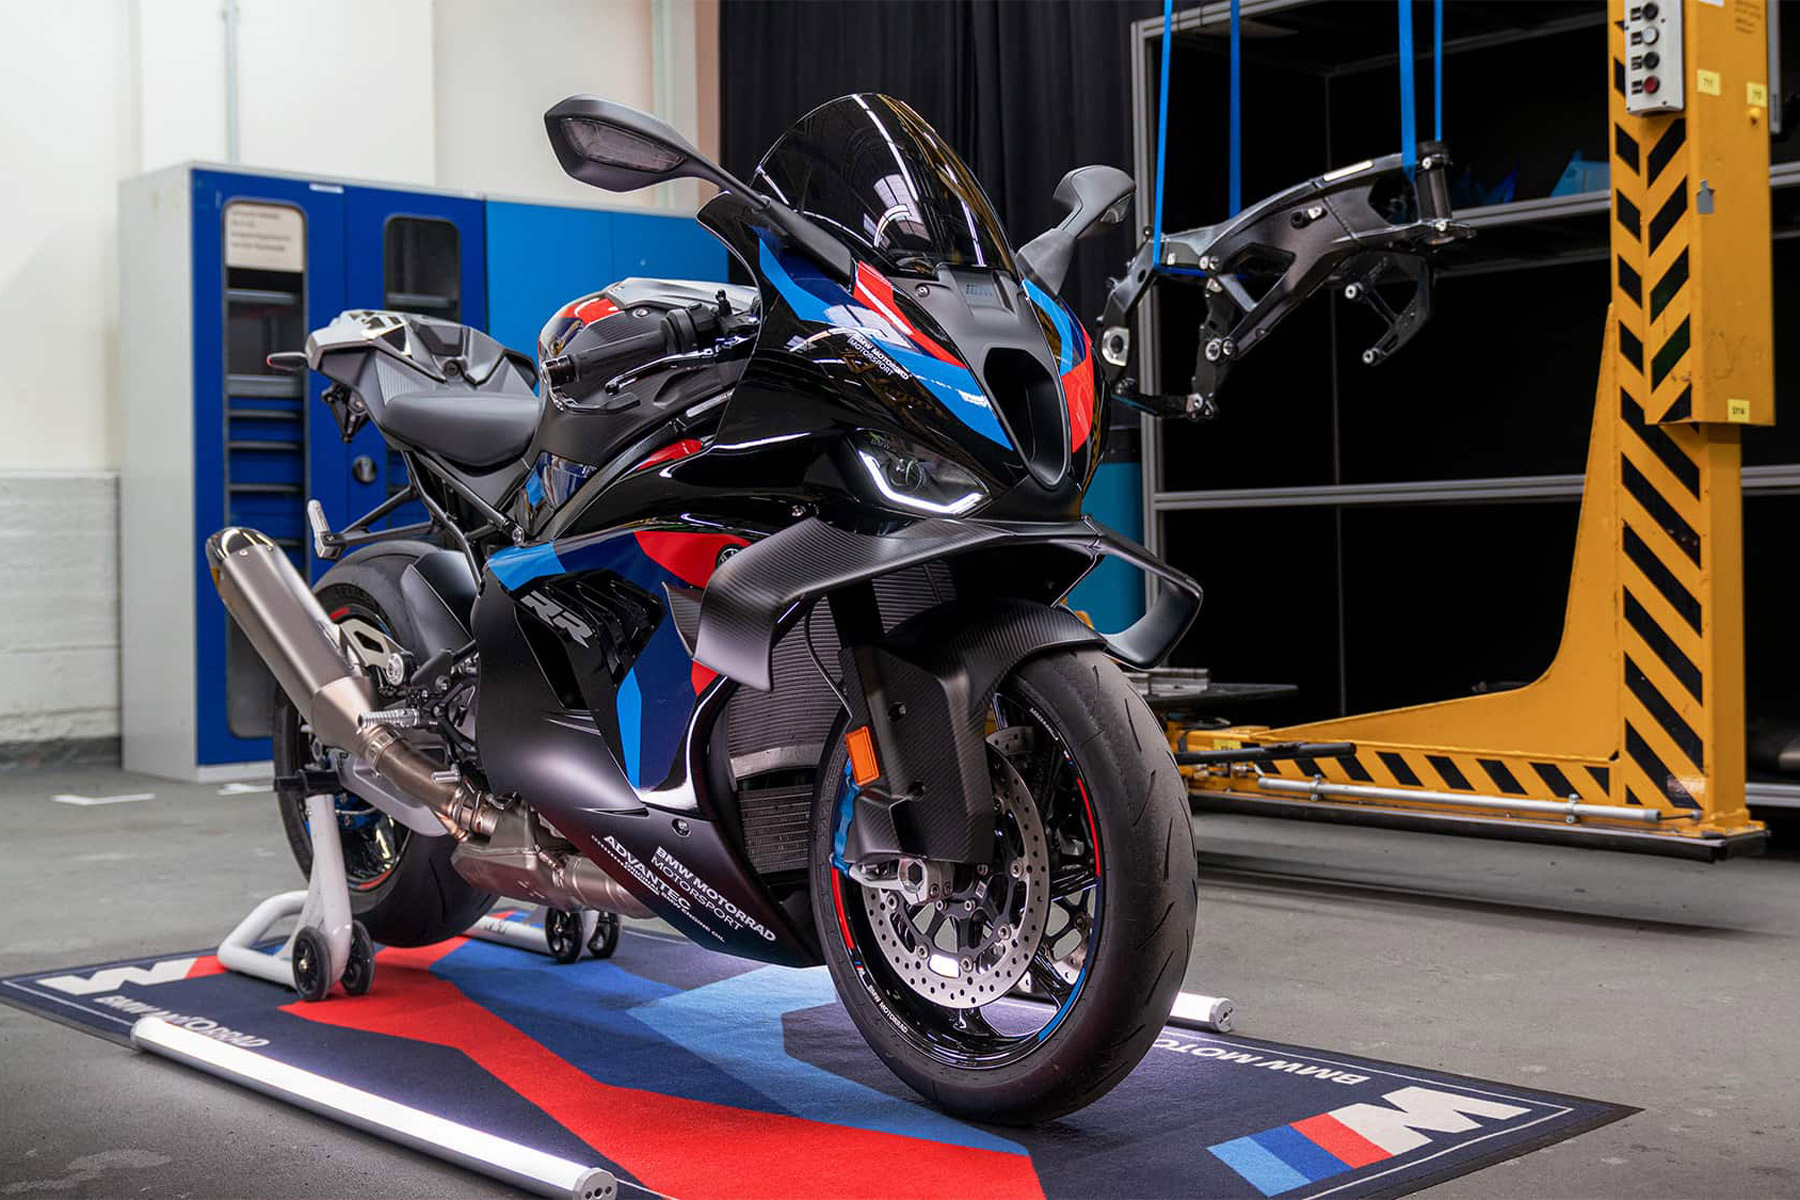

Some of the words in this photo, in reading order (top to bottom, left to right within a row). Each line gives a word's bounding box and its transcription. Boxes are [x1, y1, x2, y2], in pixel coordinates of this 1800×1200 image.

[849, 338, 894, 376] MOTORSPORT
[520, 590, 593, 648] RR
[603, 835, 692, 910] ADVANTEC
[651, 856, 744, 931] MOTORSPORT
[655, 845, 696, 879] BMW
[693, 877, 777, 942] MOTORRAD
[1259, 1055, 1372, 1086] BMW
[1326, 1085, 1533, 1156] M
